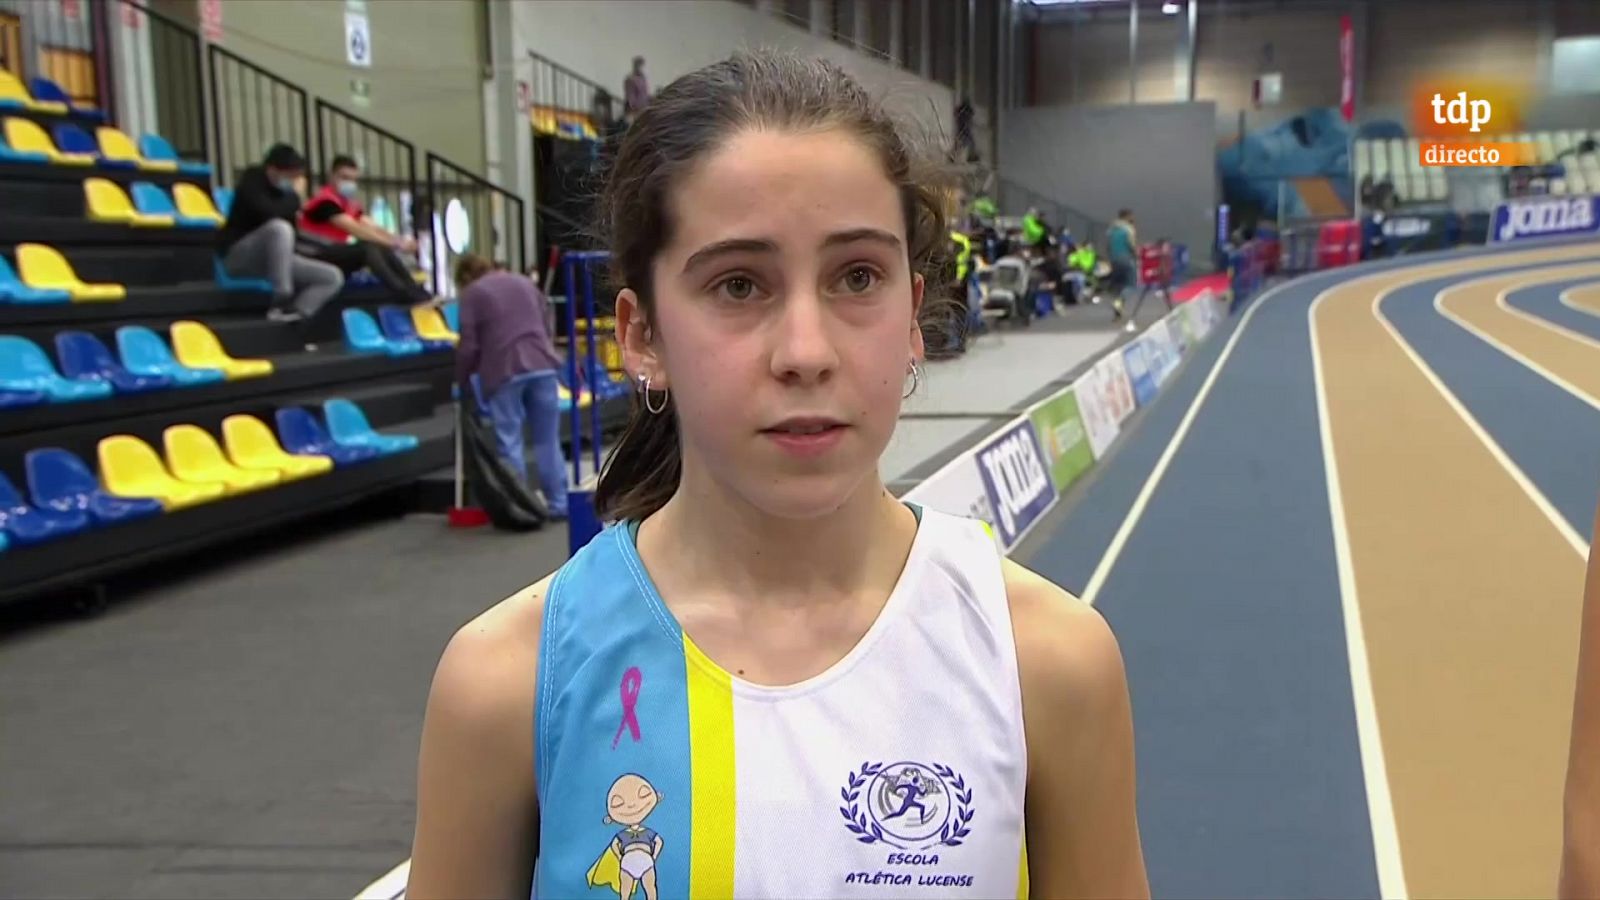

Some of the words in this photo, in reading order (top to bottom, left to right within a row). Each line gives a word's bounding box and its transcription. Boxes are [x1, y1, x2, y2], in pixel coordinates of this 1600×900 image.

[887, 853, 939, 865] ESCOLA
[845, 871, 912, 885] ATLÉTICA
[918, 875, 974, 887] LUCENSE
